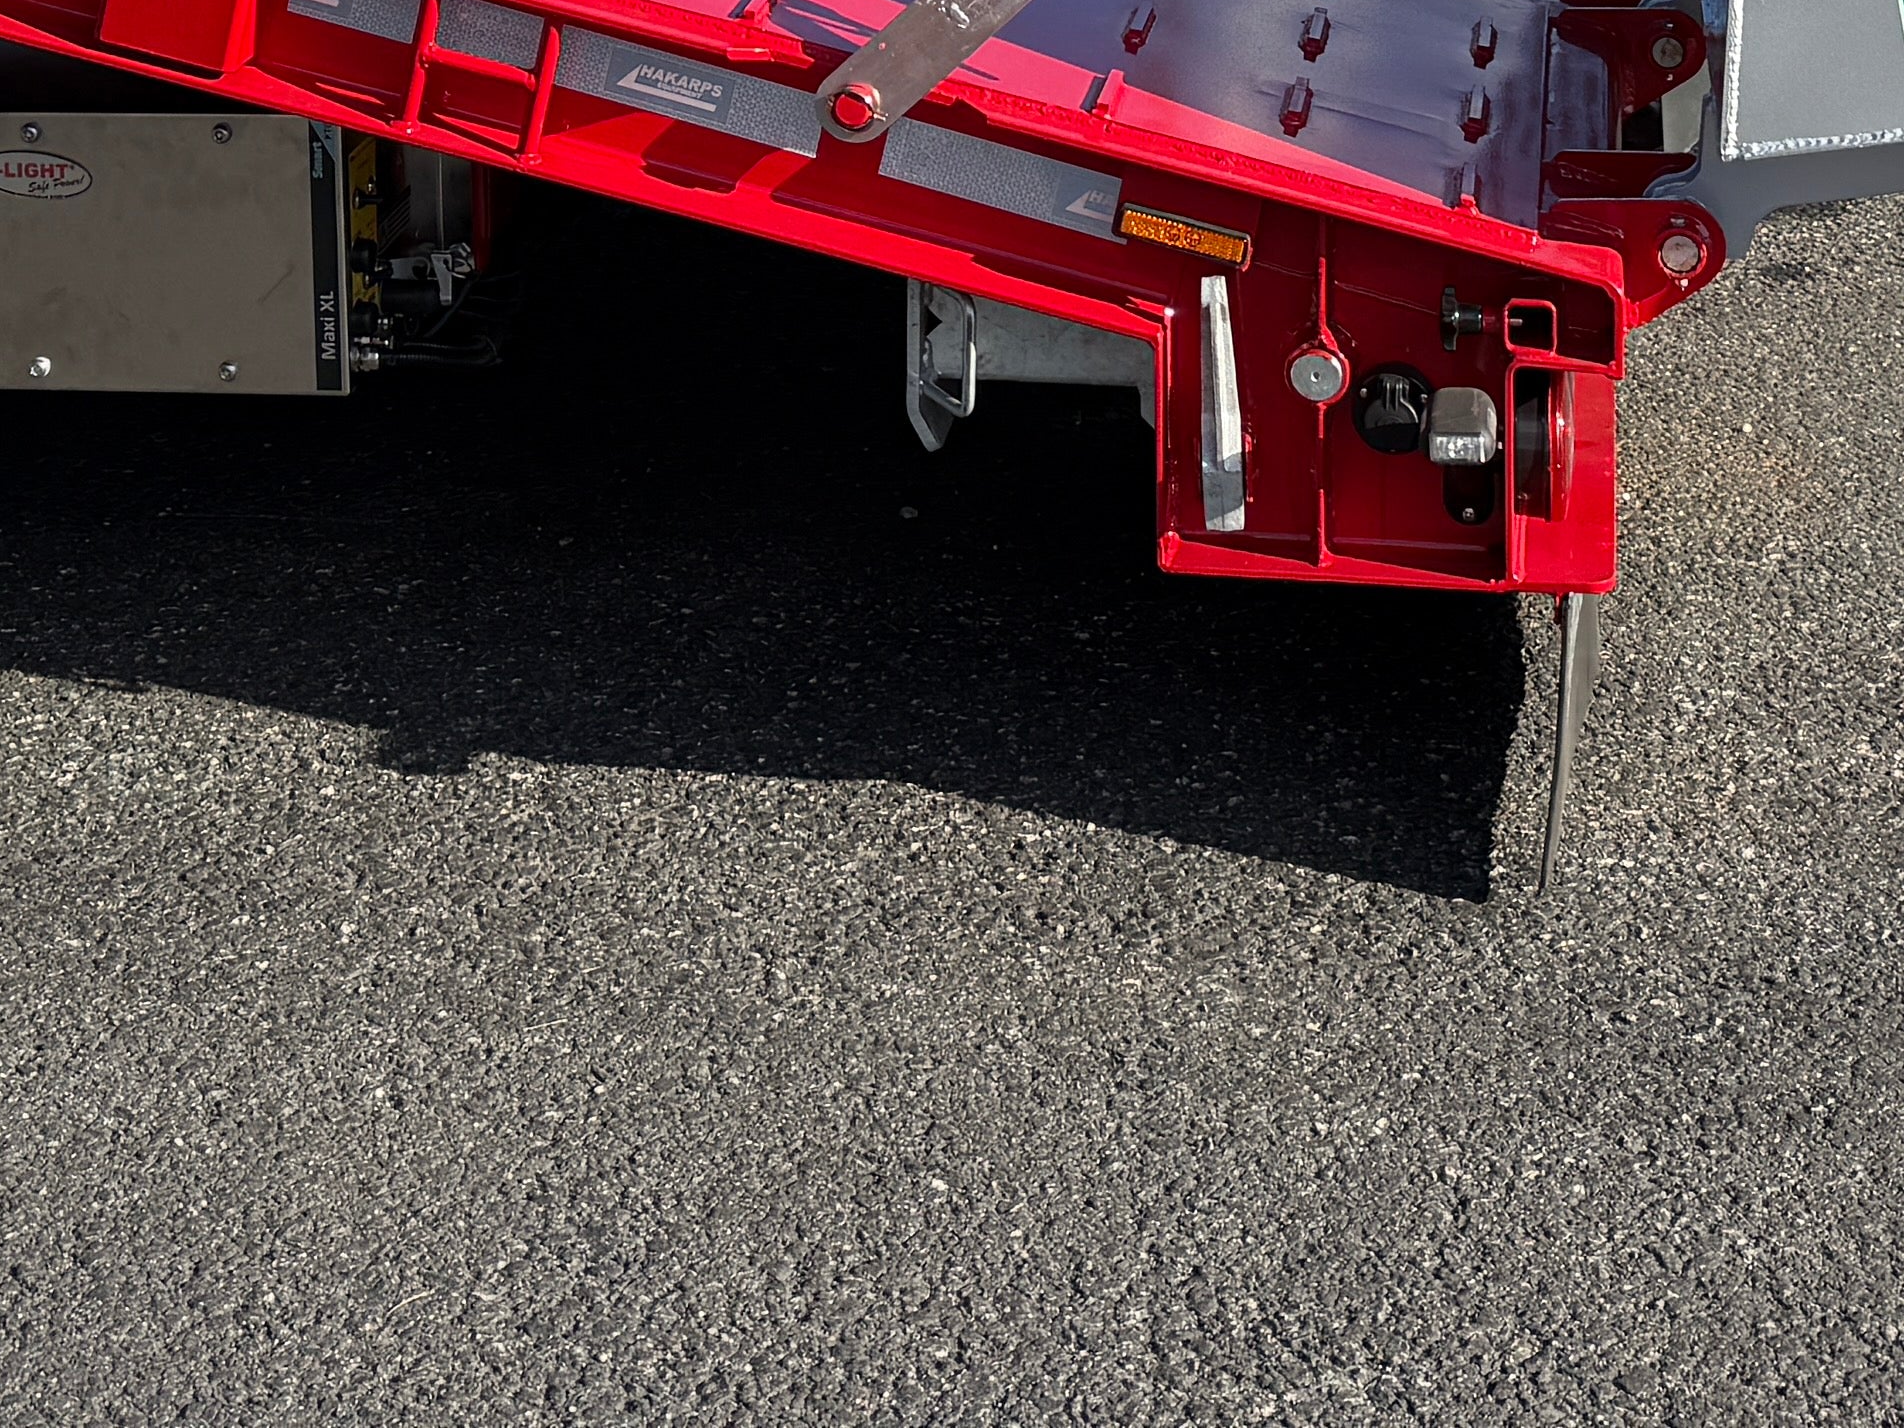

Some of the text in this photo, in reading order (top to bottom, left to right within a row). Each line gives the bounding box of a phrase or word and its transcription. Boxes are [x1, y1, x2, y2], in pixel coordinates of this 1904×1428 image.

[640, 64, 724, 98] HAKARPS
[319, 290, 337, 360] Maxi XL
